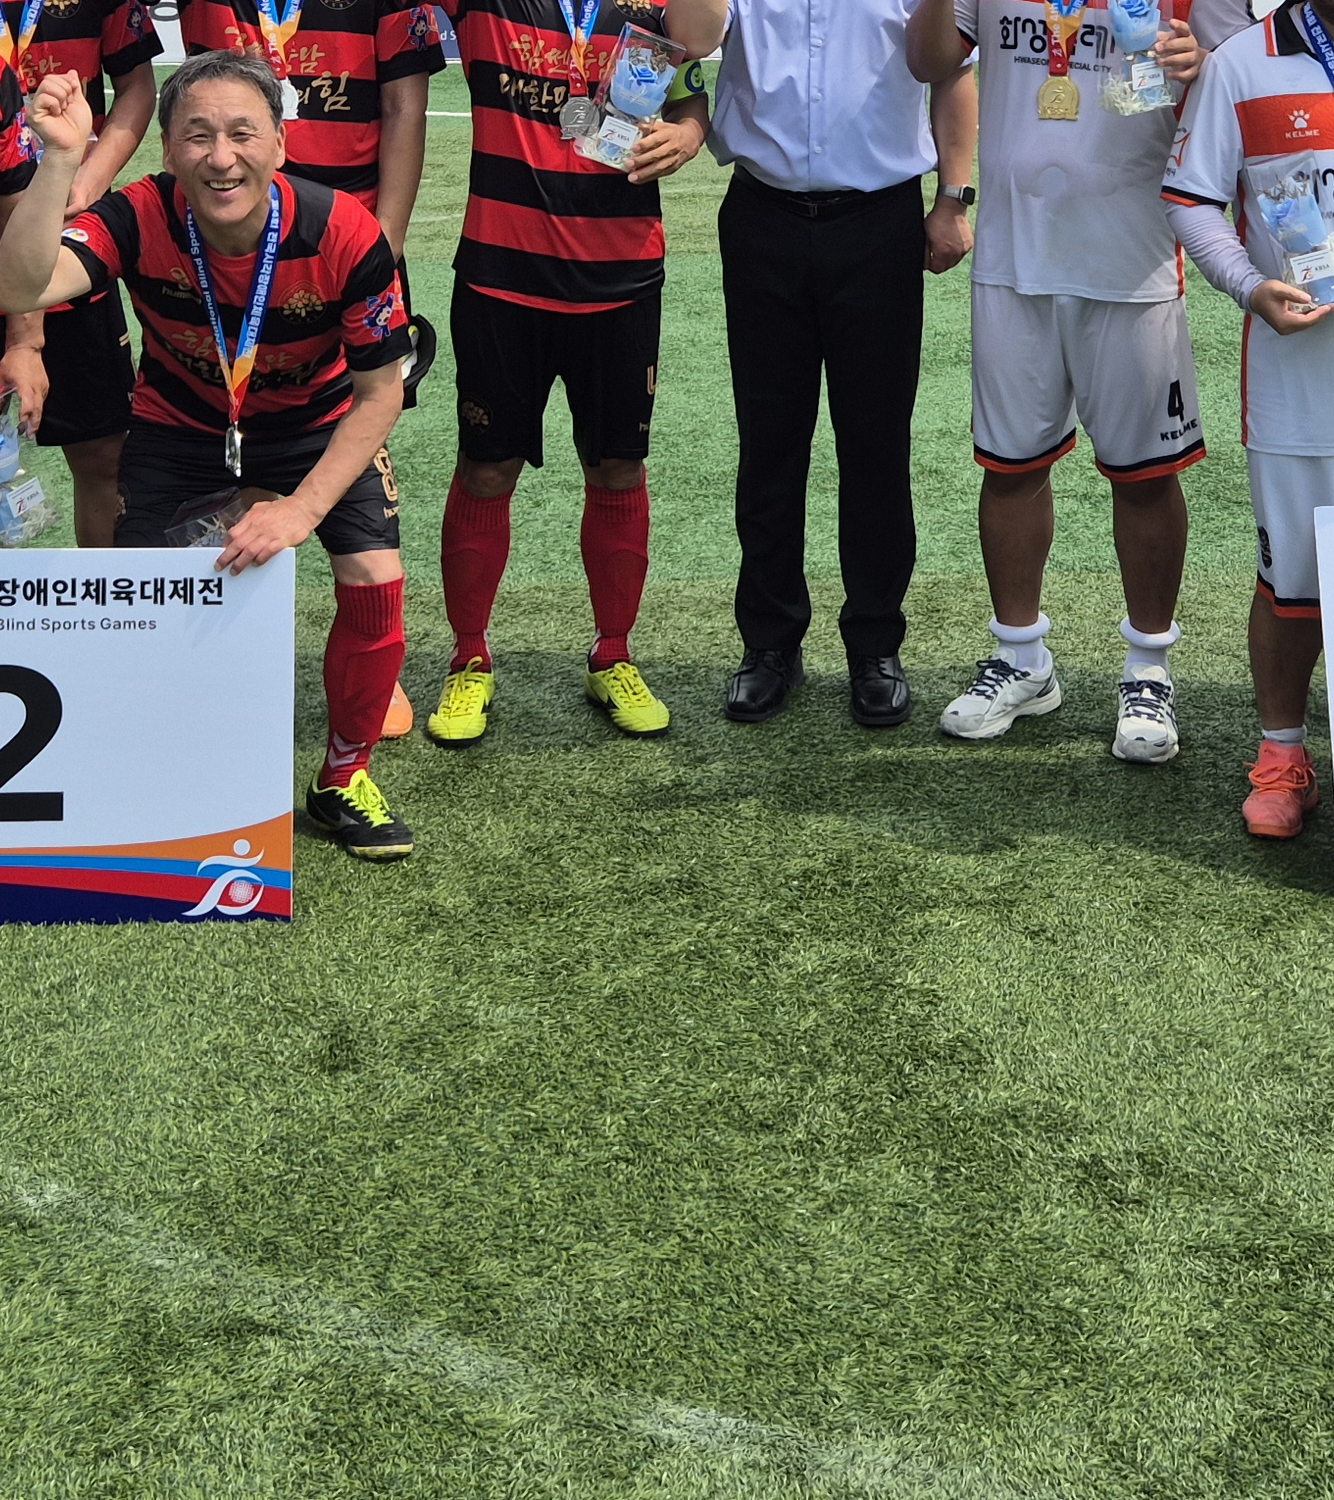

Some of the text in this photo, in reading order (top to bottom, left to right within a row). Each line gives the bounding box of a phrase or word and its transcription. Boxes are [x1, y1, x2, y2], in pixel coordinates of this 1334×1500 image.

[1051, 22, 1061, 46] The
[312, 71, 351, 112] 힘
[1285, 128, 1320, 139] KELME
[1166, 380, 1186, 422] 4
[41, 617, 96, 635] Sports
[100, 616, 157, 632] Games
